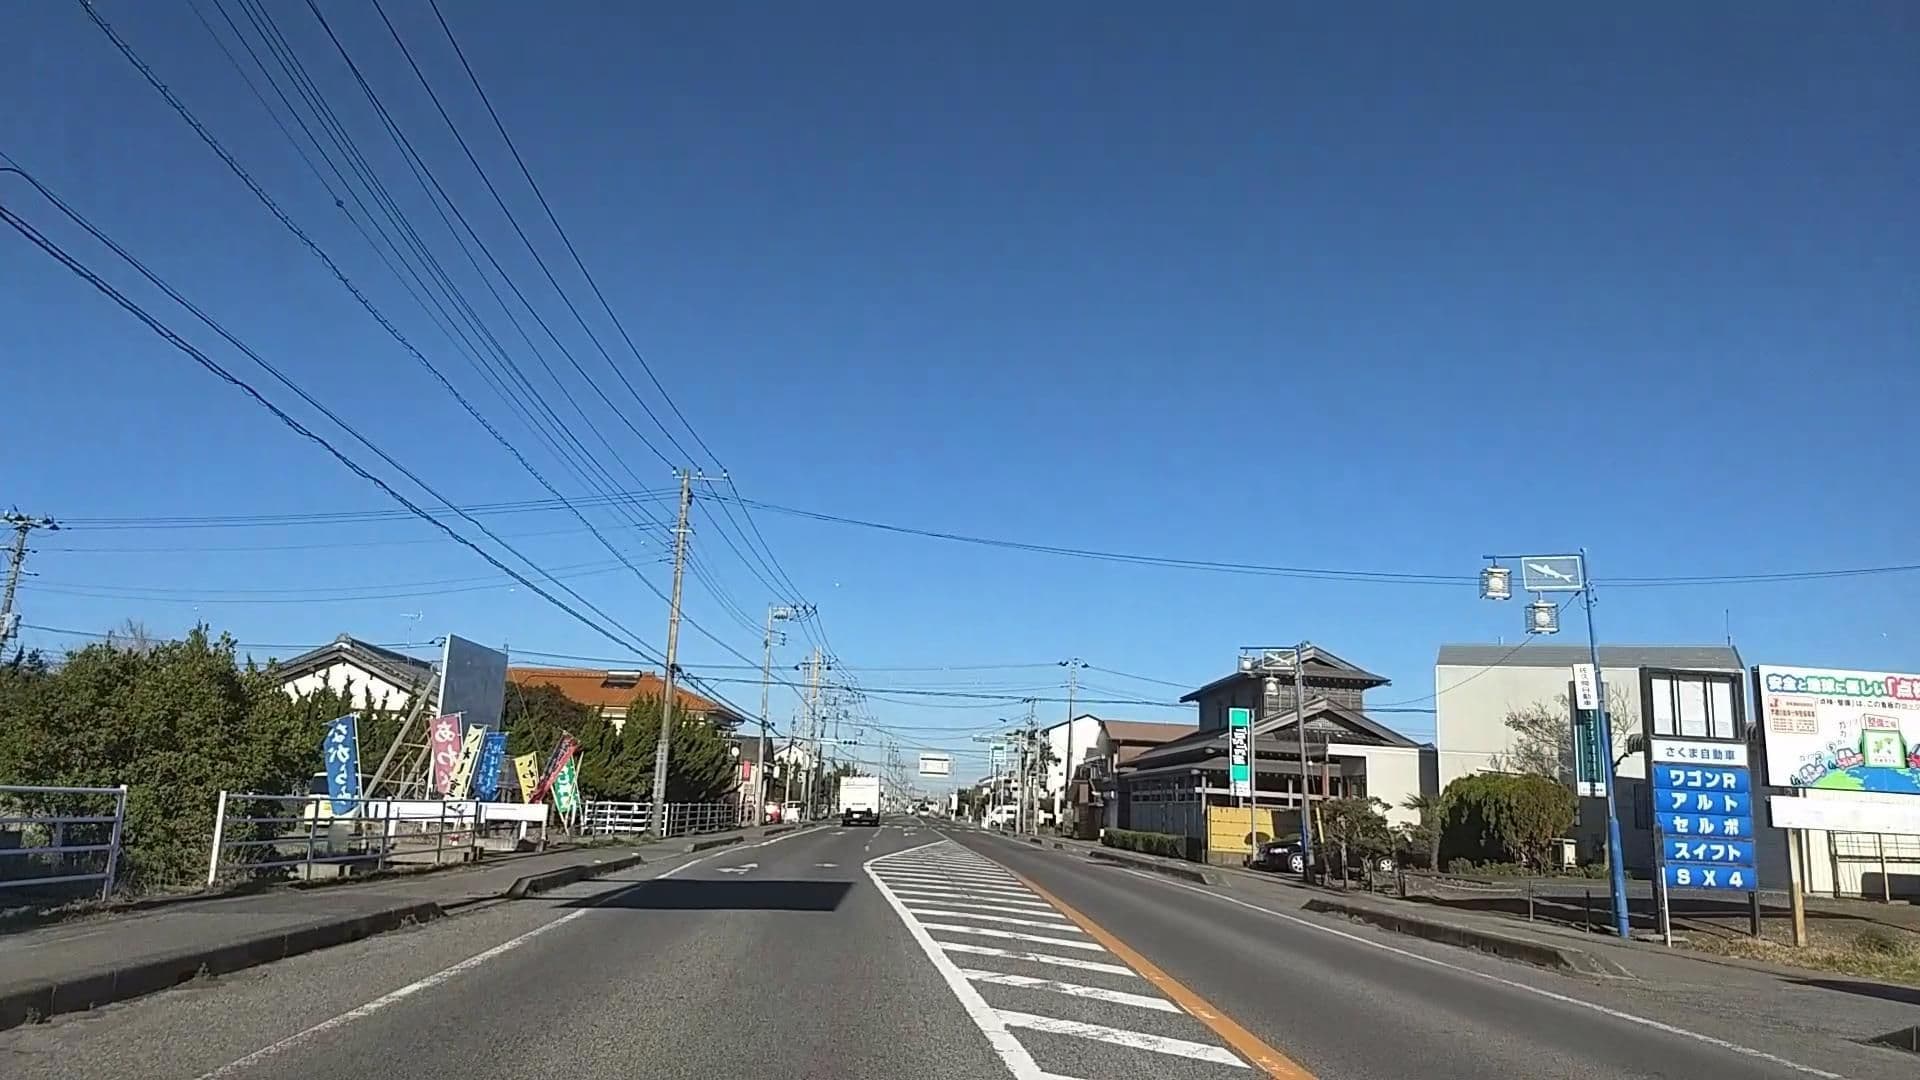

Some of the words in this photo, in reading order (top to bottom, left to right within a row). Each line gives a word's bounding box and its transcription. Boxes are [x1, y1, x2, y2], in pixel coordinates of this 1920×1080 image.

[1666, 747, 1735, 760] さくま自動車
[1669, 769, 1736, 789] ワゴンR
[1671, 792, 1738, 812] アルト
[1674, 842, 1741, 861] スイフト
